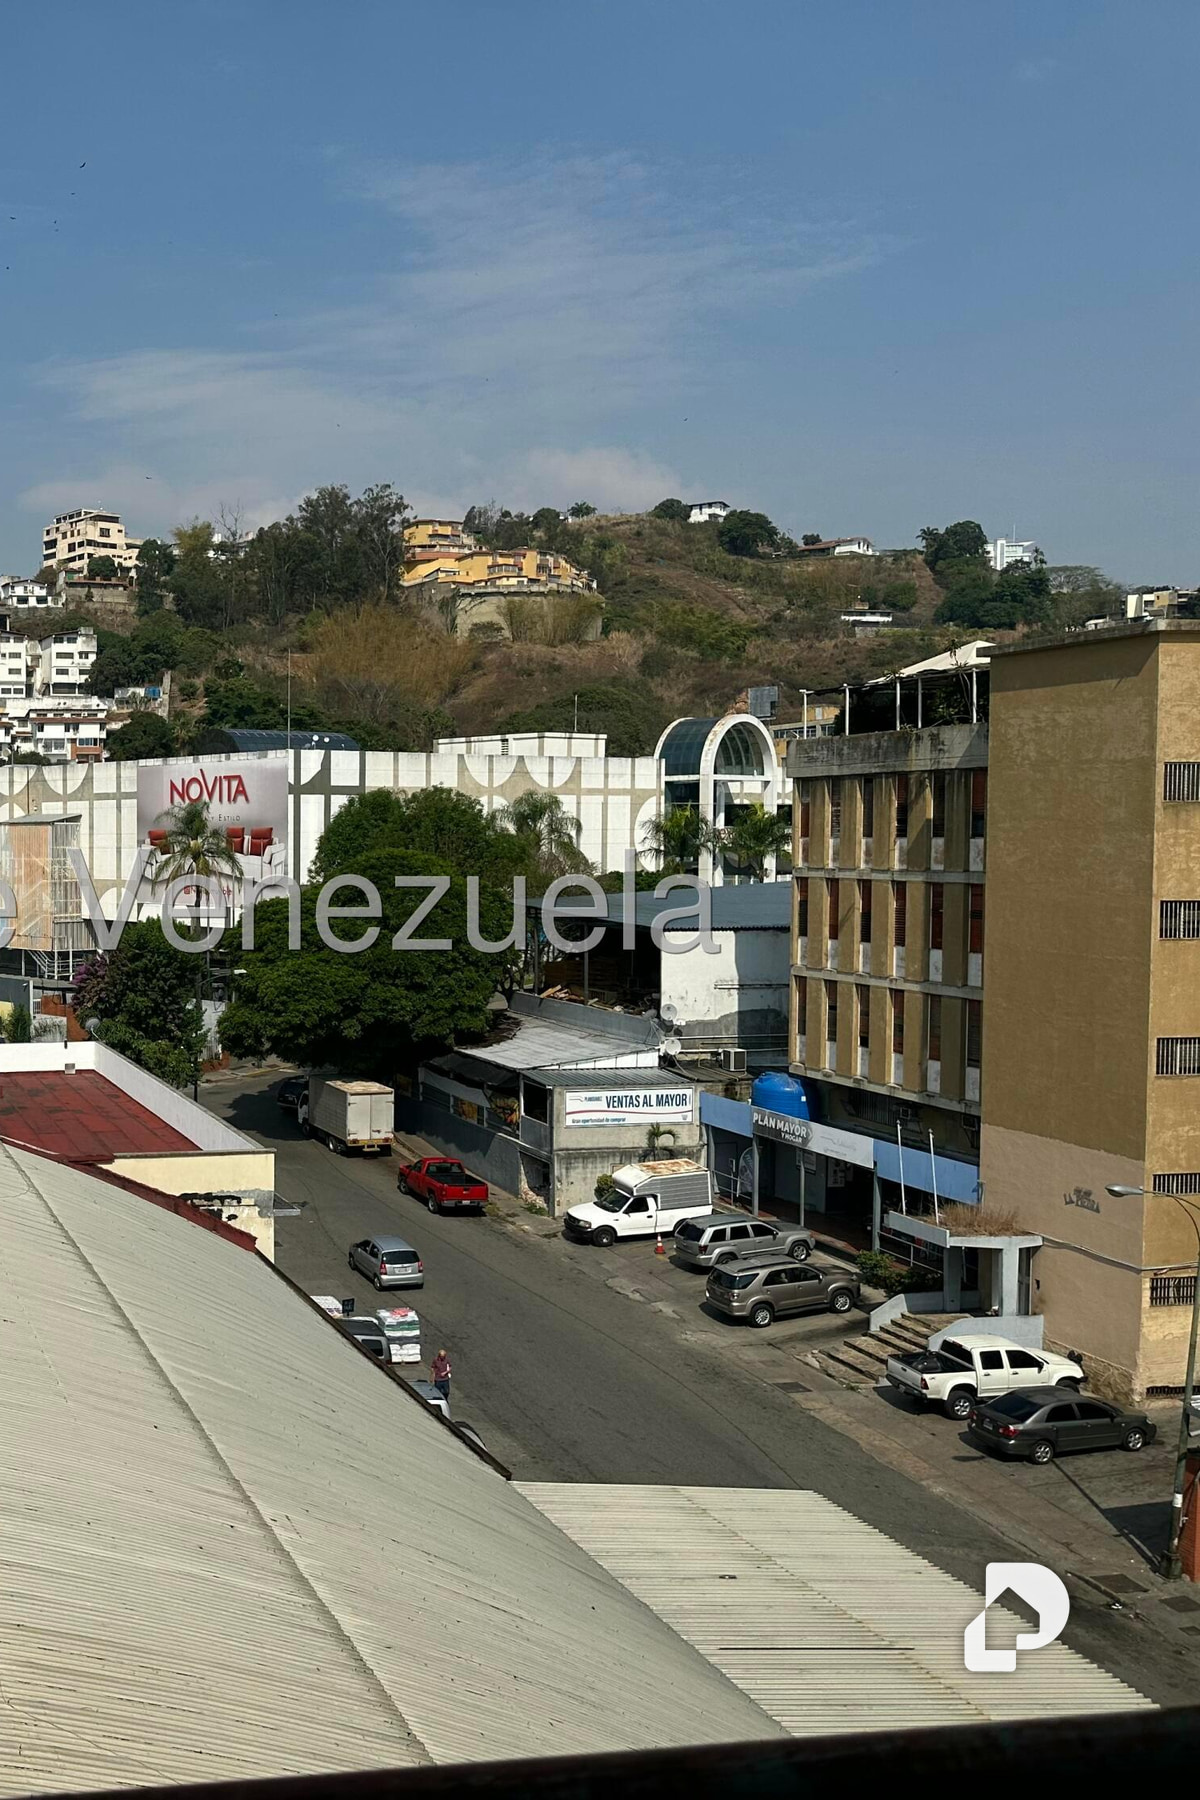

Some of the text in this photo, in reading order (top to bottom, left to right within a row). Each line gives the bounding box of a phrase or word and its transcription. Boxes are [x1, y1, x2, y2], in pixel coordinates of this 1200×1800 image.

[169, 768, 250, 805] NOVITA
[605, 1094, 641, 1109] VENTAS
[642, 1094, 654, 1108] AL
[655, 1093, 688, 1107] MAYOR
[753, 1112, 807, 1138] PLAN MAYOR
